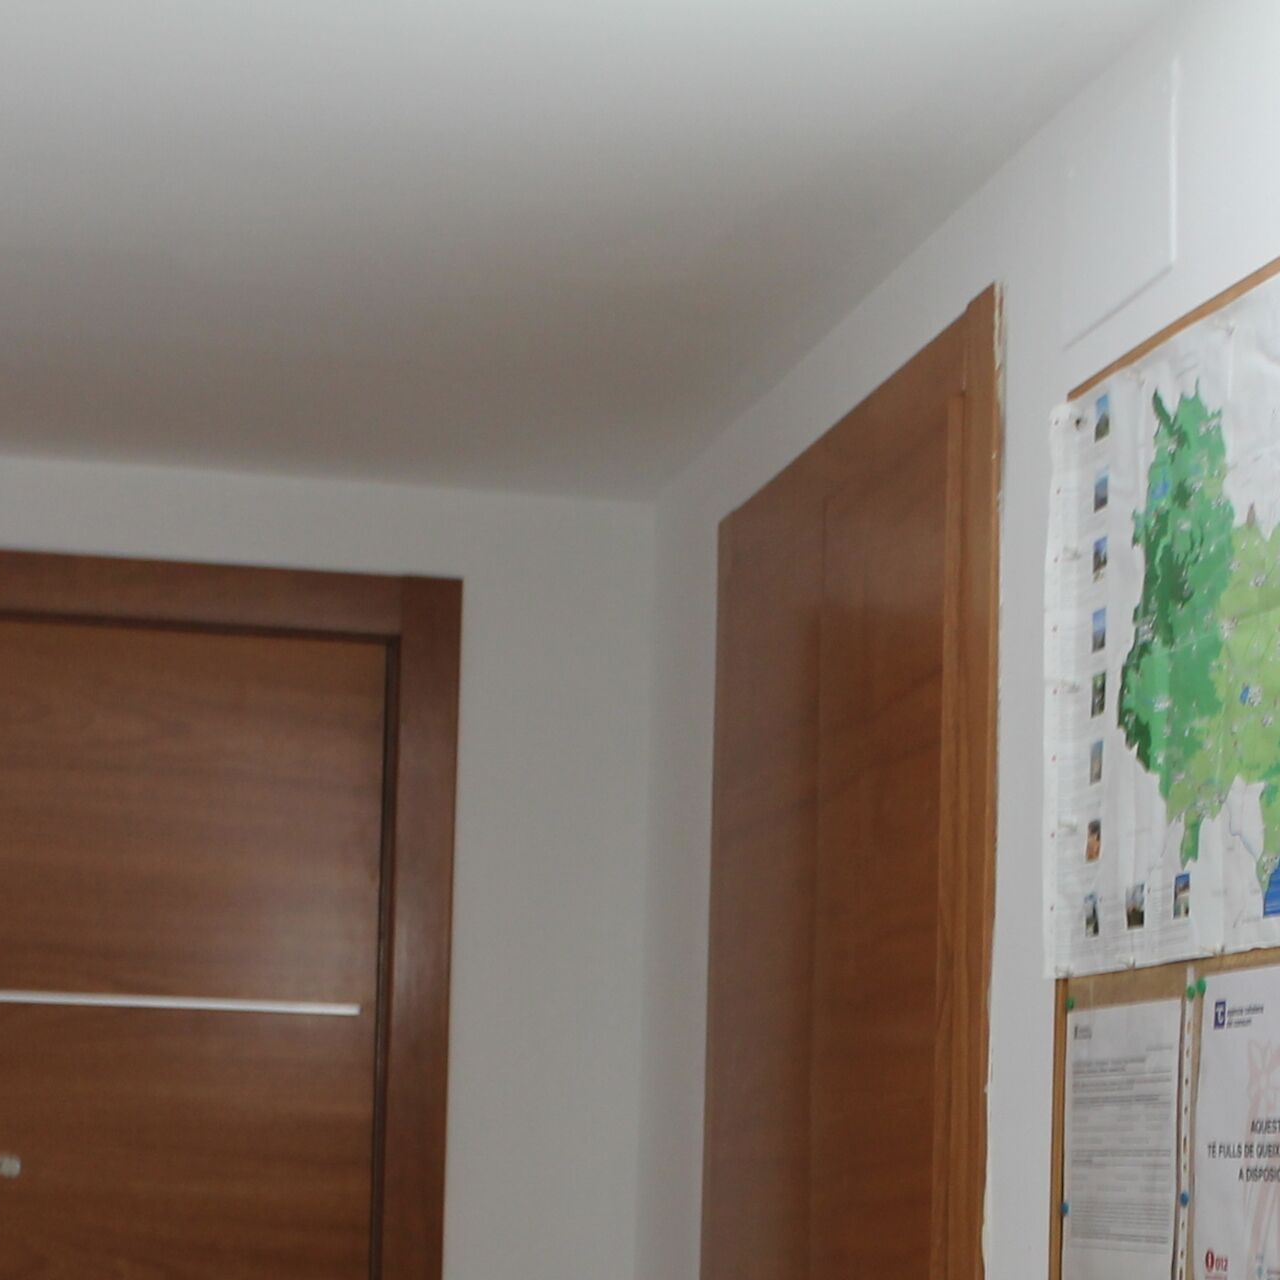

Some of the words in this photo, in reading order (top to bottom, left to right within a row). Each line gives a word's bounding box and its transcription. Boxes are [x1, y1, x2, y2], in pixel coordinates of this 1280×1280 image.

[1208, 1141, 1217, 1158] TÉ
[1218, 1144, 1242, 1159] FULLS
[1244, 1144, 1254, 1158] DE
[1238, 1168, 1245, 1182] A
